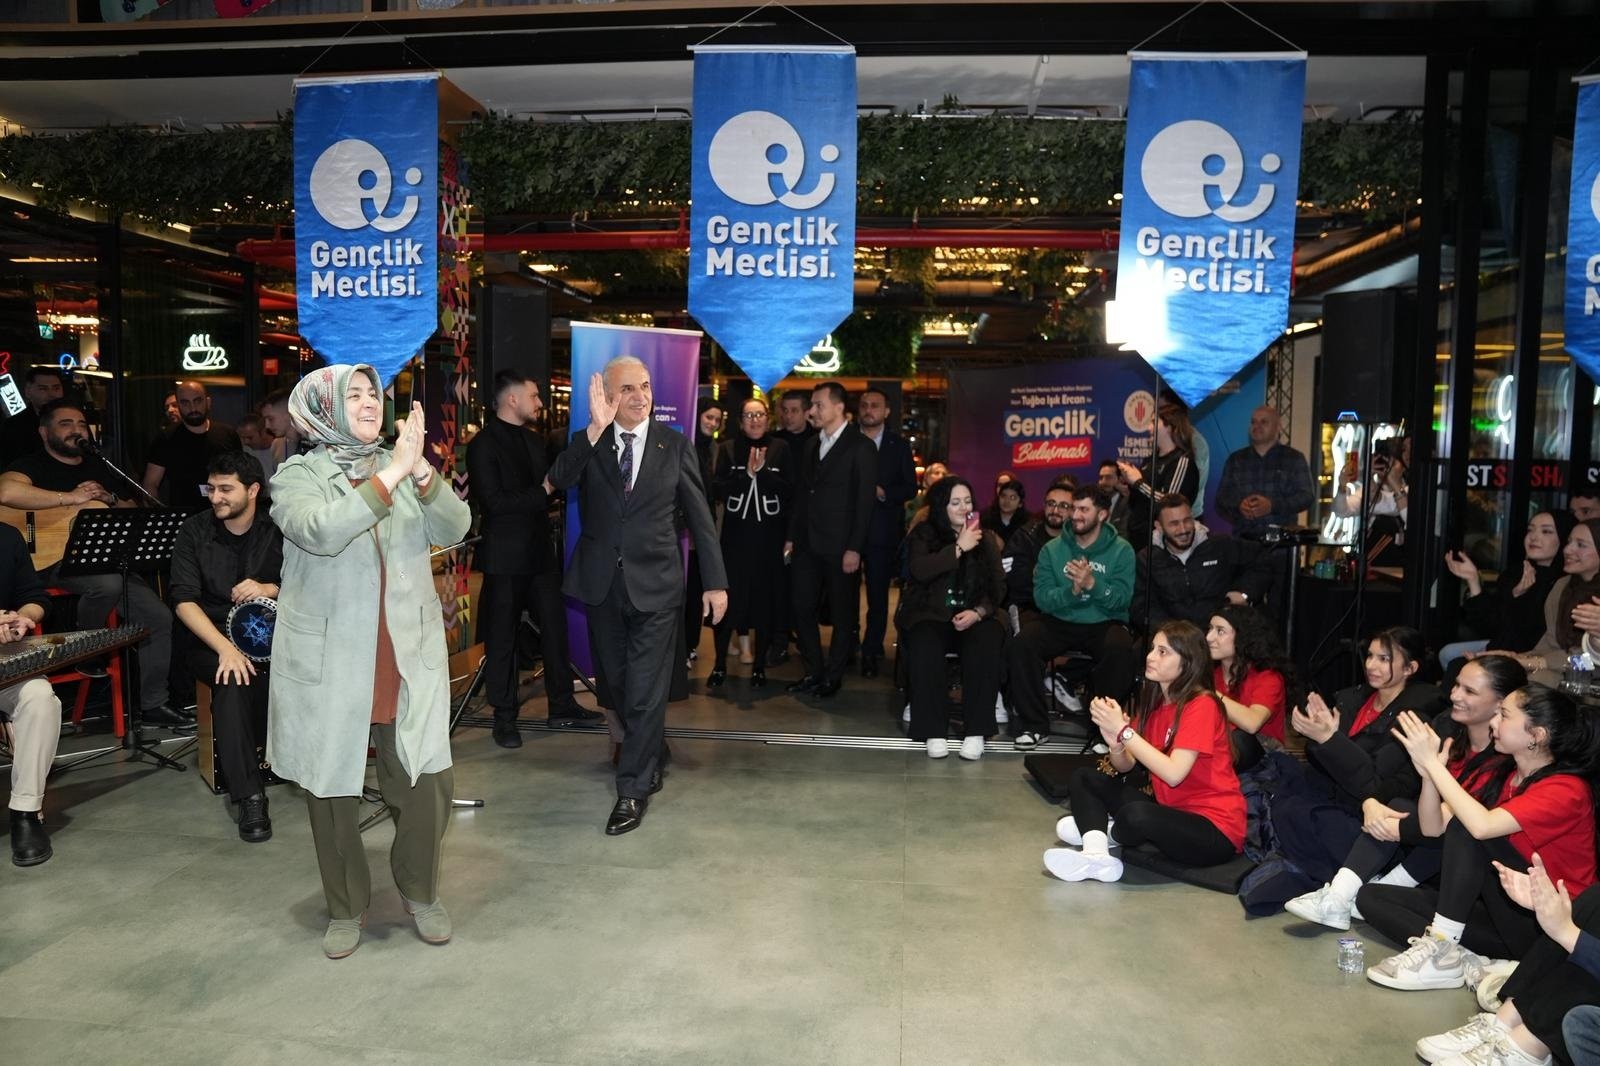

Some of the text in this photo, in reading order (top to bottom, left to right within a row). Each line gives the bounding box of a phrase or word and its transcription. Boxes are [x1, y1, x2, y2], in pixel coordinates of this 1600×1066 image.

[707, 215, 839, 248] Gençlik
[1136, 226, 1276, 264] Gençlik
[310, 238, 423, 270] Gençlik
[706, 247, 836, 278] Meclisi.
[311, 268, 422, 298] Meclisi.
[1061, 394, 1086, 405] Ercan
[655, 414, 670, 422] can
[1005, 409, 1096, 438] Gençlik
[1013, 441, 1089, 463] Buluşması
